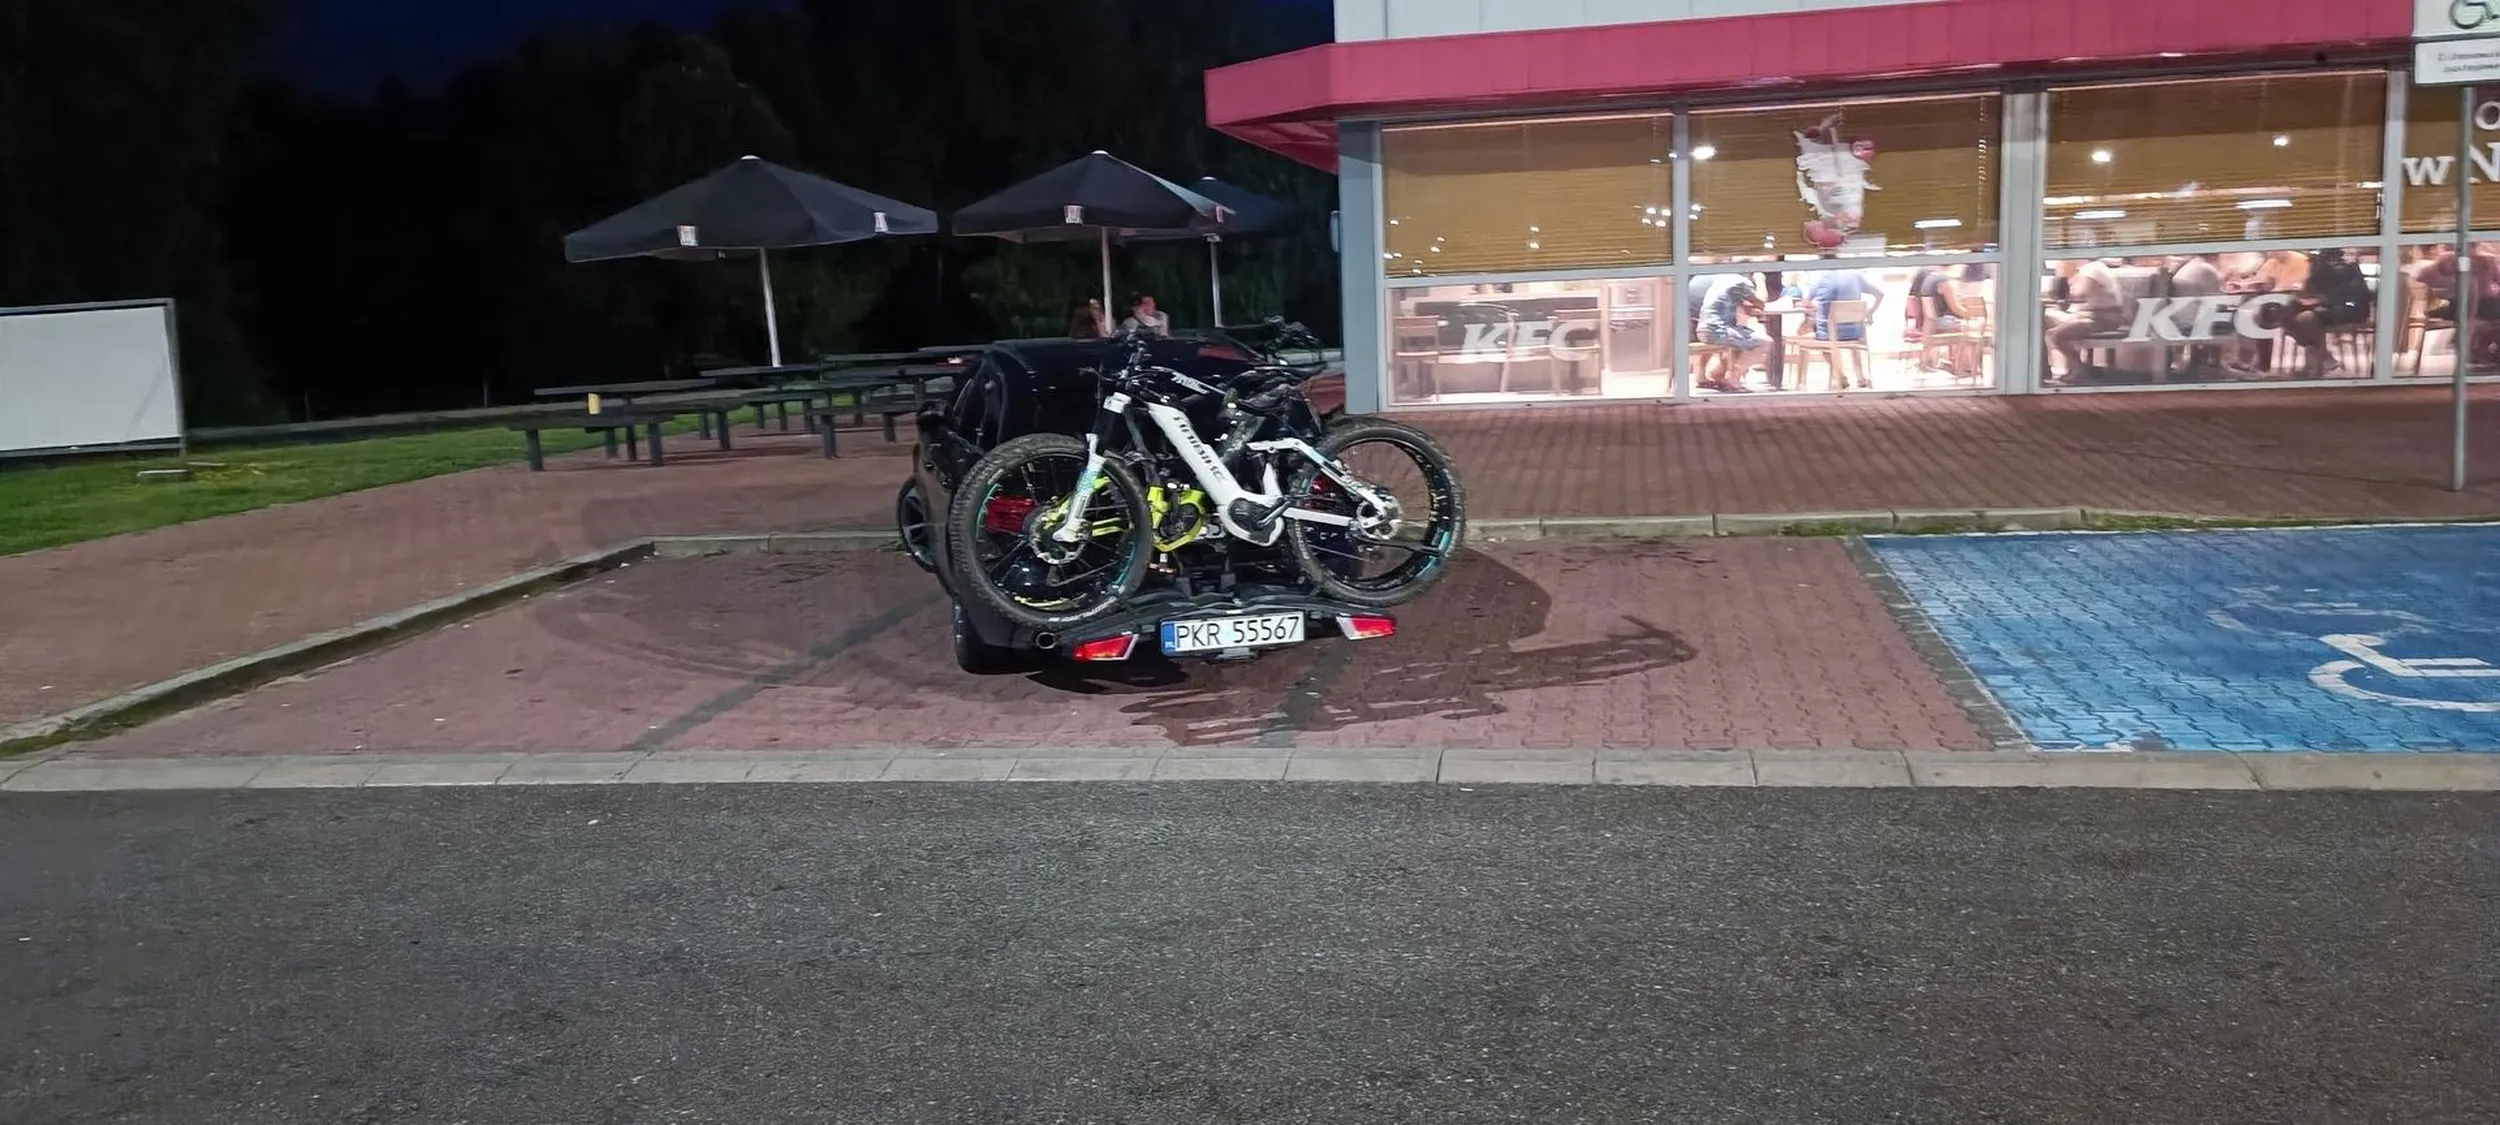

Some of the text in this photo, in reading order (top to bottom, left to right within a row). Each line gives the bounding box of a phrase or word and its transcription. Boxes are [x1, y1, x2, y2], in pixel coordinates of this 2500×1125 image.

[2122, 293, 2293, 342] KFC
[1461, 319, 1599, 361] KFC
[1177, 616, 1299, 648] PKR 55567
